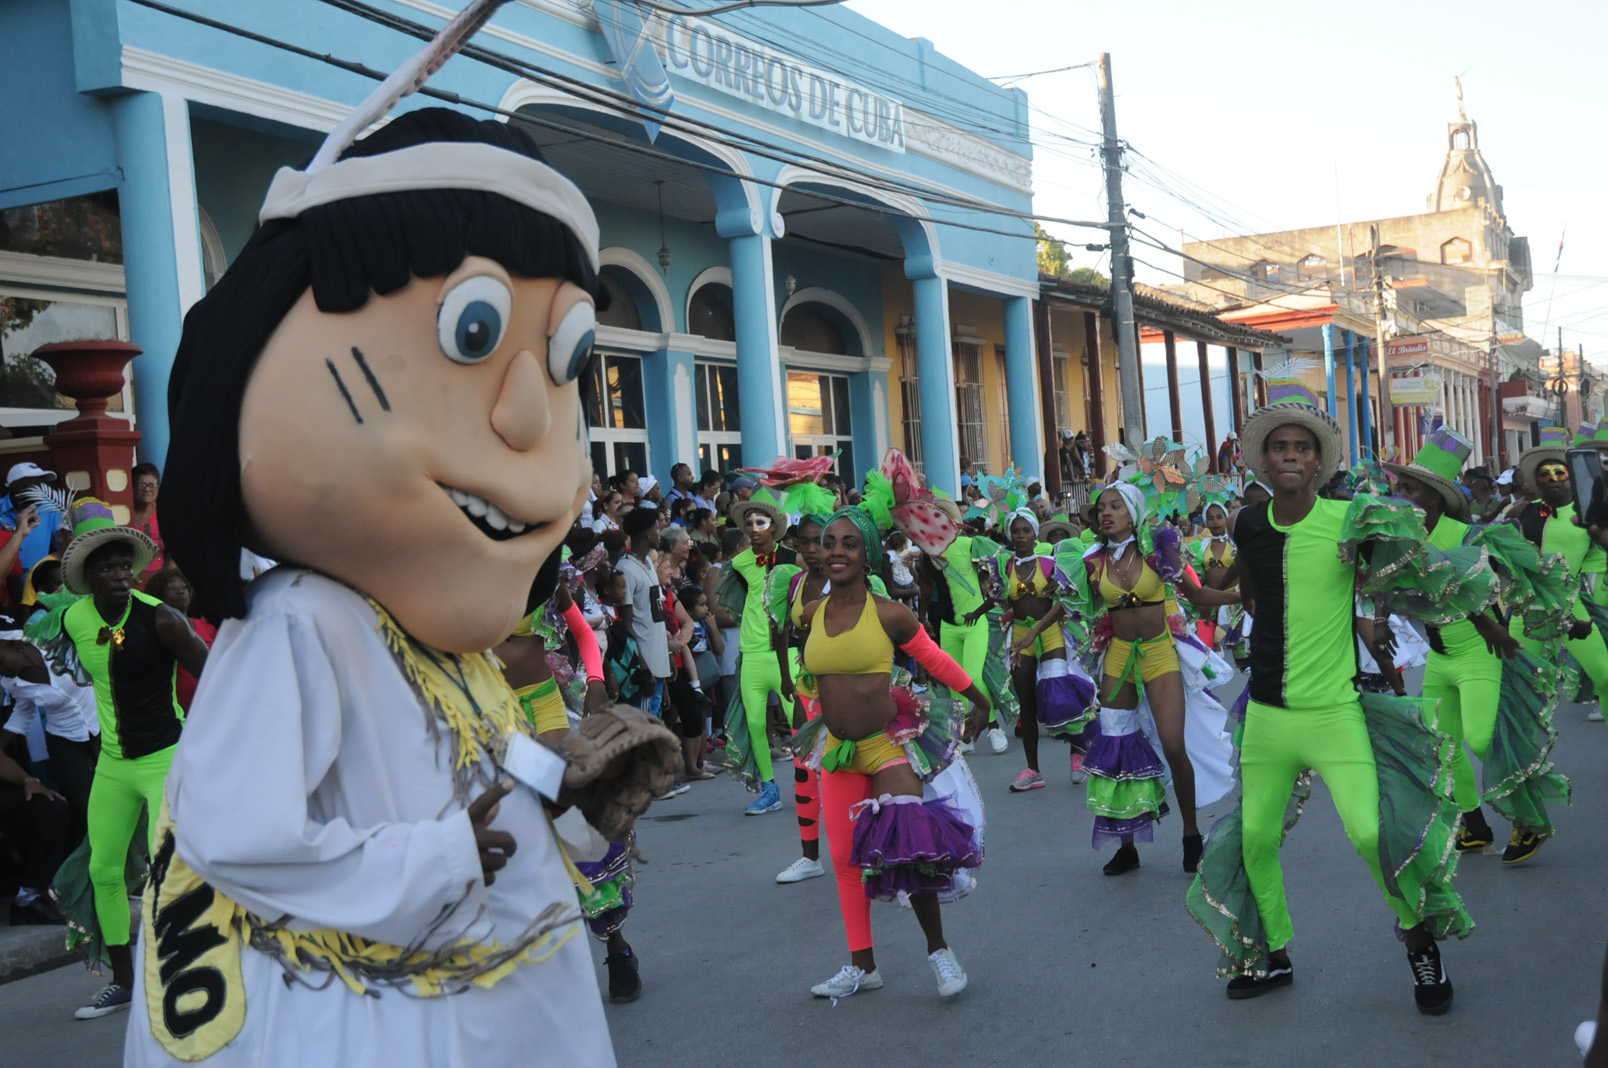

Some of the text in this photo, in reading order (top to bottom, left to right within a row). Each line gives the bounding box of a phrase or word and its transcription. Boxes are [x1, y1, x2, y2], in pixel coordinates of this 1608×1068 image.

[666, 13, 905, 148] CORREOS DE CUBA
[1398, 343, 1427, 355] Brindis
